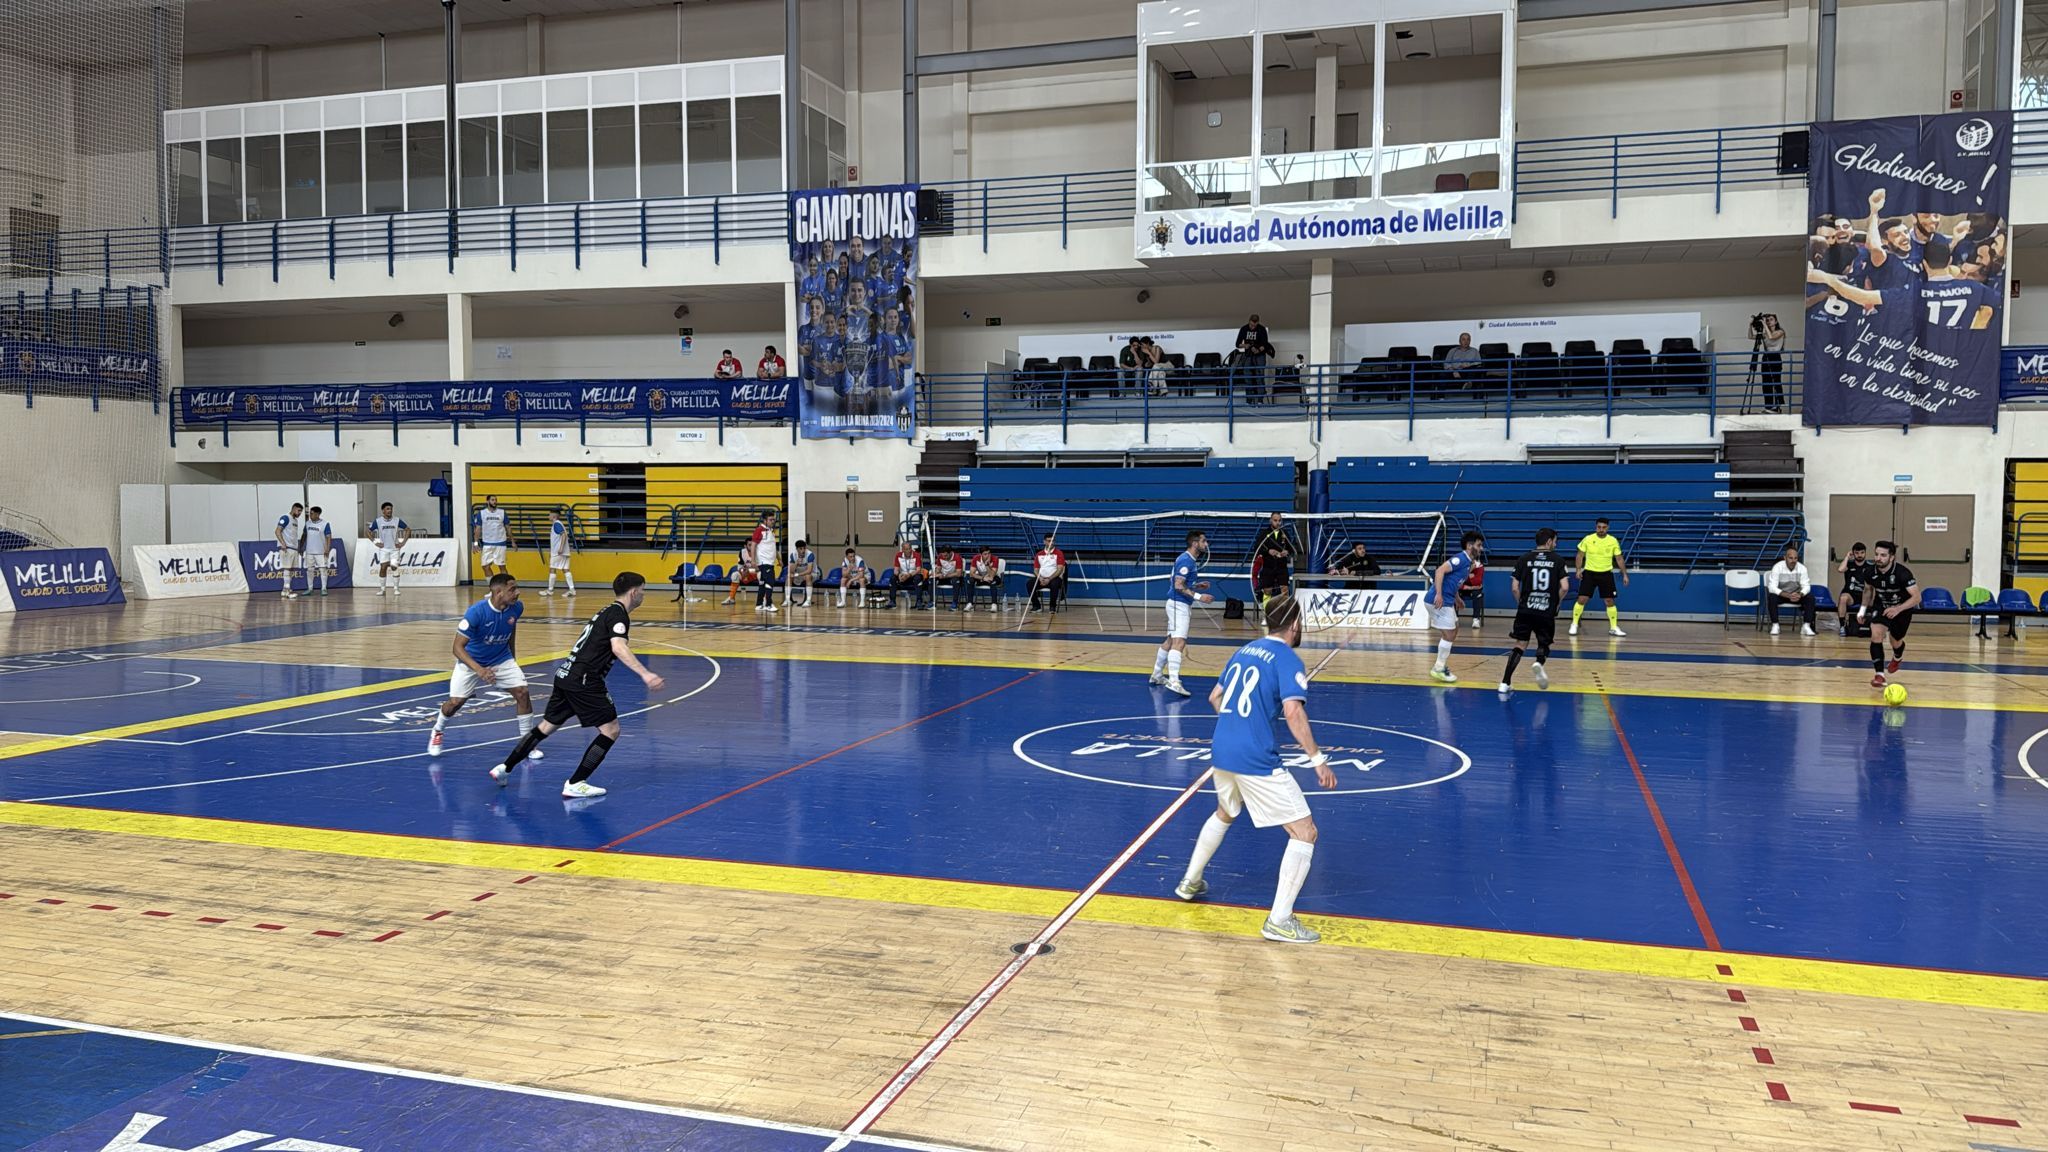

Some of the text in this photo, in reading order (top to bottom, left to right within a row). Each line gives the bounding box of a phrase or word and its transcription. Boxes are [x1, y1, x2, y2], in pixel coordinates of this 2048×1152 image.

[1835, 143, 1967, 194] Gladiadores
[796, 191, 917, 243] CAMPEONAS
[1184, 205, 1505, 246] Ciudad Autónoma de Melilla
[1927, 299, 1968, 327] 17
[1879, 335, 1905, 356] que
[1907, 337, 1959, 369] hacemos
[41, 360, 90, 375] MELILLA
[99, 355, 149, 373] MELILLA
[1824, 343, 1981, 400] en la vida tiene su eco
[1839, 372, 1858, 389] en
[1862, 372, 1880, 393] la
[190, 391, 235, 407] MELILLA
[313, 389, 360, 407] MELILLA
[443, 387, 494, 404] MELILLA
[581, 386, 637, 403] MELILLA
[731, 384, 790, 401] MELILLA
[263, 401, 305, 413] MELILLA
[389, 400, 434, 412] MELILLA
[525, 398, 573, 411] MELILLA
[671, 396, 721, 409] MELILLA
[158, 555, 230, 577] MELILLA
[370, 551, 446, 567] MLILLA
[14, 560, 107, 587] MELILLA
[162, 574, 231, 585] CIUDAD DEL DEPORTE
[412, 567, 440, 575] DEPORTE
[1531, 567, 1550, 591] 19
[21, 583, 109, 598] CIUDAD DEL DEPORTE
[1308, 592, 1418, 617] MELILLA
[1347, 616, 1366, 626] DEL
[1369, 616, 1414, 627] DEPORTE
[1219, 662, 1261, 718] 28
